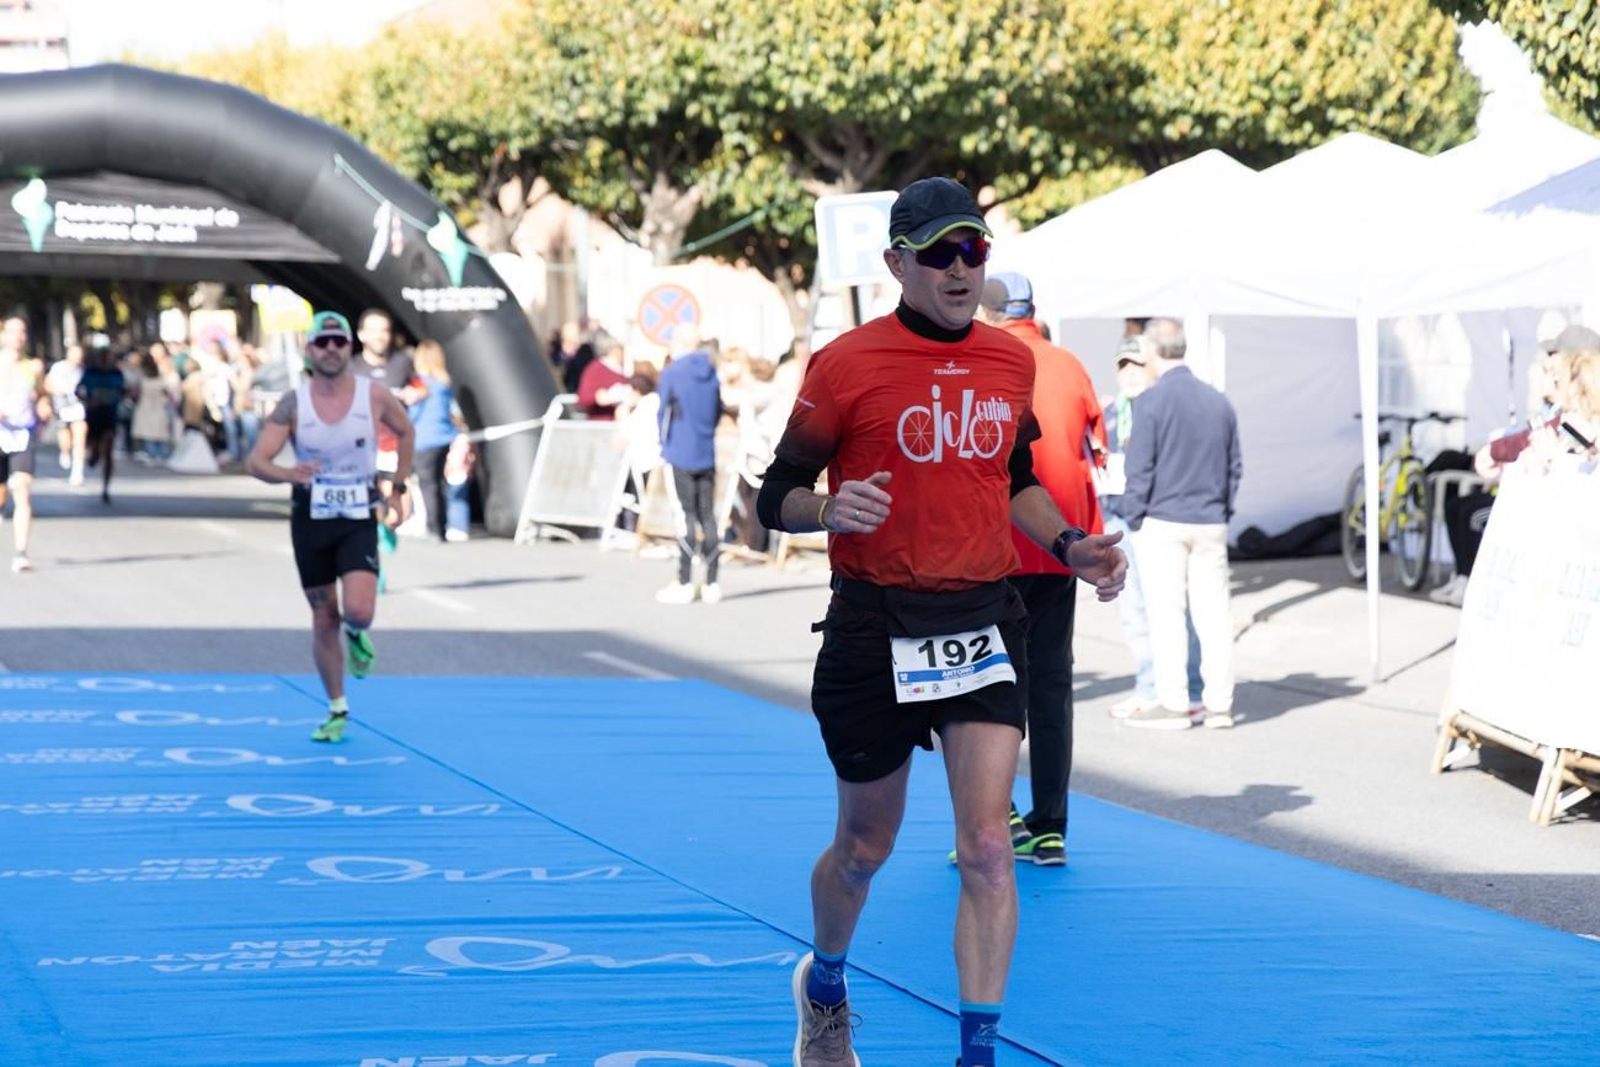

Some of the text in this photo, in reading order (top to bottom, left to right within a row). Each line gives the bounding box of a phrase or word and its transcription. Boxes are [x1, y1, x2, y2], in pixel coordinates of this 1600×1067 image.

[837, 206, 887, 277] P
[323, 488, 357, 504] 681
[917, 634, 992, 668] 192
[941, 665, 975, 678] ANTONIO
[149, 958, 380, 973] MEDIA
